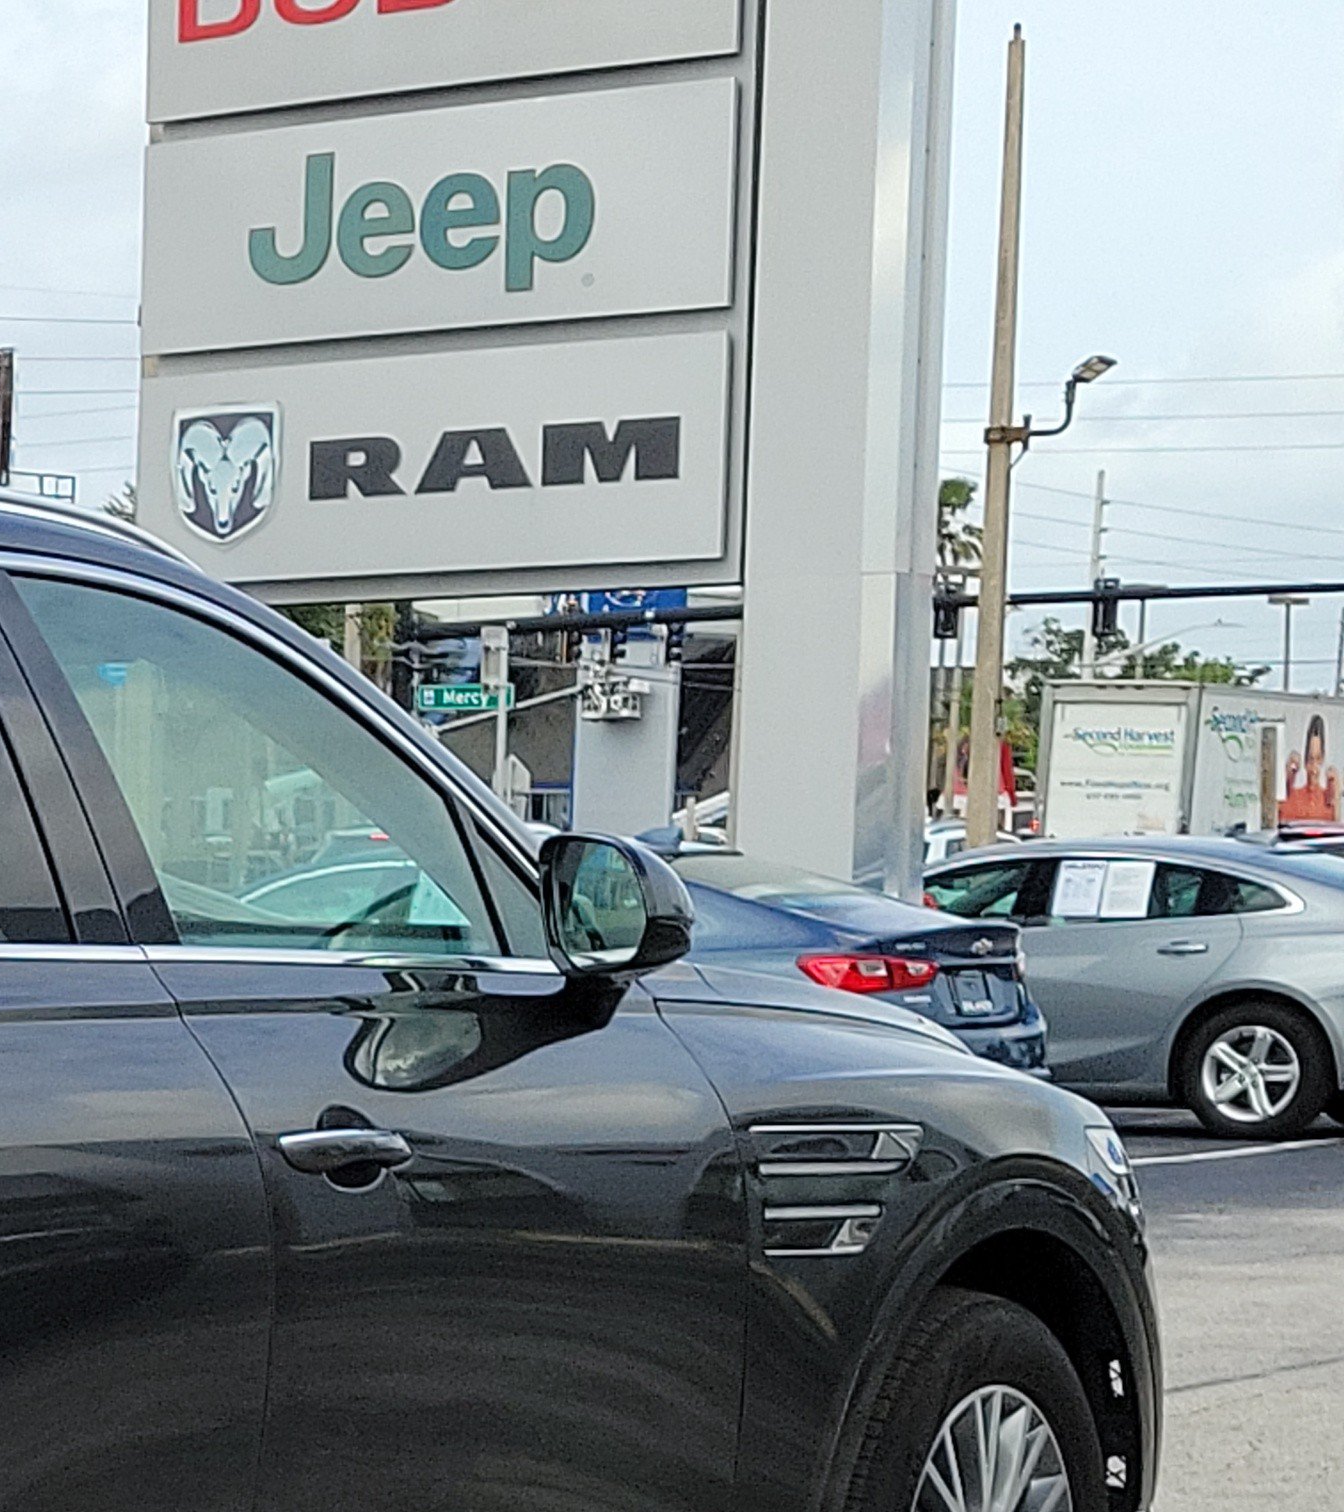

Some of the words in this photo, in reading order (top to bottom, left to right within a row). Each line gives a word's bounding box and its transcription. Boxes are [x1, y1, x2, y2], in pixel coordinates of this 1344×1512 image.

[248, 151, 595, 292] Jeep
[309, 416, 680, 501] RAM
[443, 689, 489, 708] Mercy
